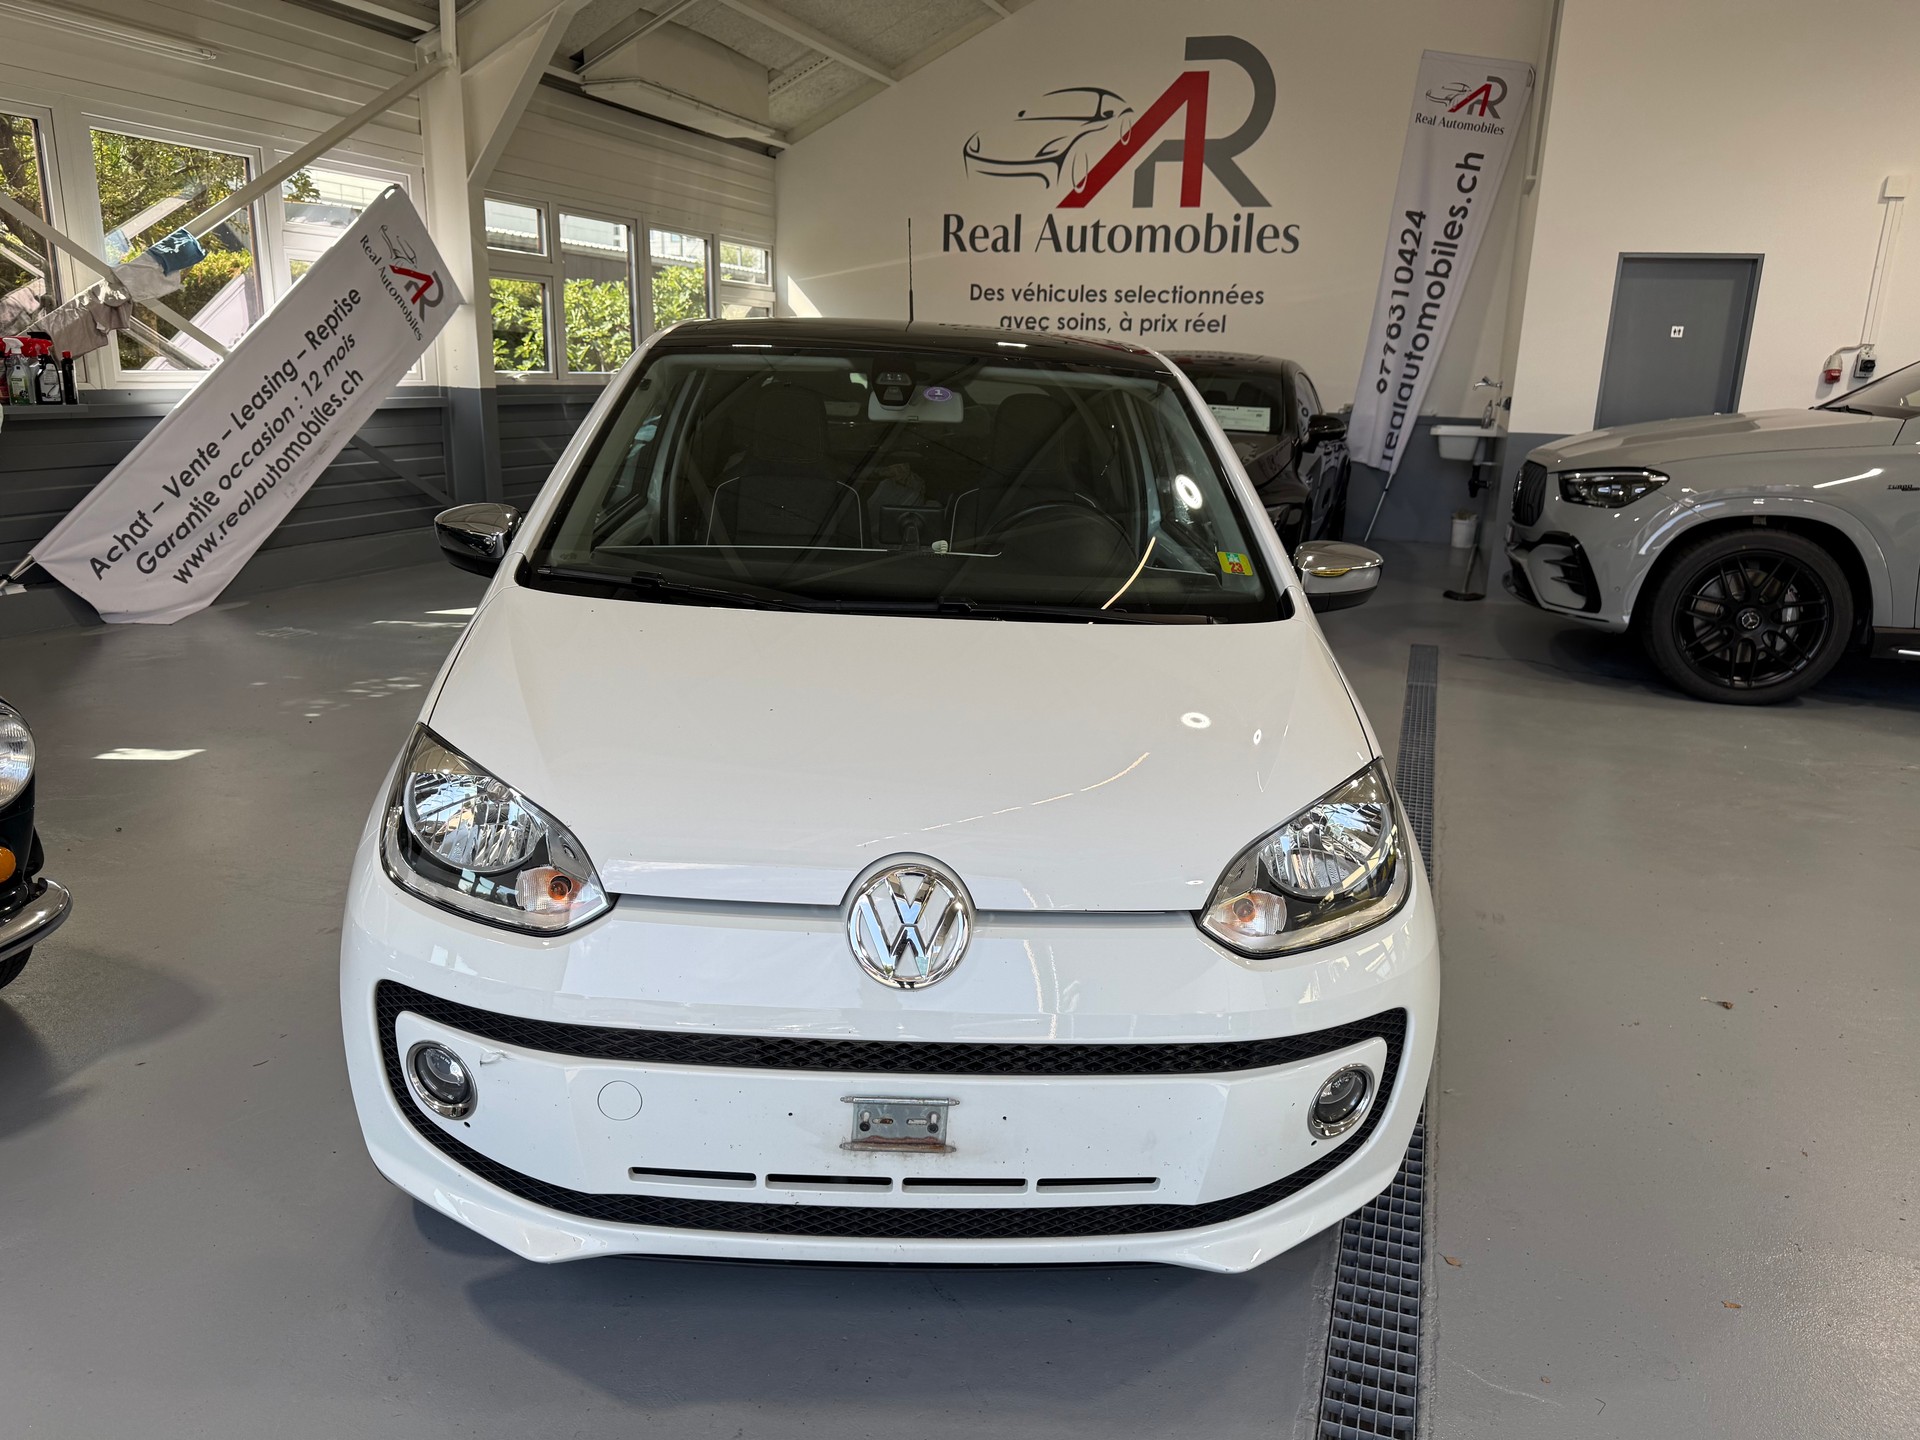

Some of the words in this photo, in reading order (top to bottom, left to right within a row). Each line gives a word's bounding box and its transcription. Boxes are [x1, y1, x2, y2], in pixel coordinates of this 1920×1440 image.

[1415, 113, 1436, 126] Real
[1438, 117, 1505, 135] Automobiles
[942, 214, 1021, 253] Real
[1034, 213, 1300, 254] Automobiles
[360, 234, 382, 265] Real
[378, 266, 423, 341] Automobiles
[970, 284, 1005, 301] Des
[1012, 282, 1107, 303] véhicules
[1114, 284, 1264, 304] selectionnées
[1057, 313, 1111, 333] soins,
[1119, 312, 1133, 331] à
[1140, 313, 1178, 336] prix
[1184, 312, 1226, 333] réel
[1376, 210, 1427, 394] 0778310424
[89, 513, 153, 580] Achat
[162, 442, 220, 499] Vente
[230, 359, 299, 430] Leasing
[303, 289, 361, 350] Reprise
[136, 490, 220, 574] Garantie
[218, 405, 296, 492] occasion
[301, 370, 324, 399] 12
[324, 333, 356, 376] mois
[172, 367, 364, 585] www.realautomobiles.ch
